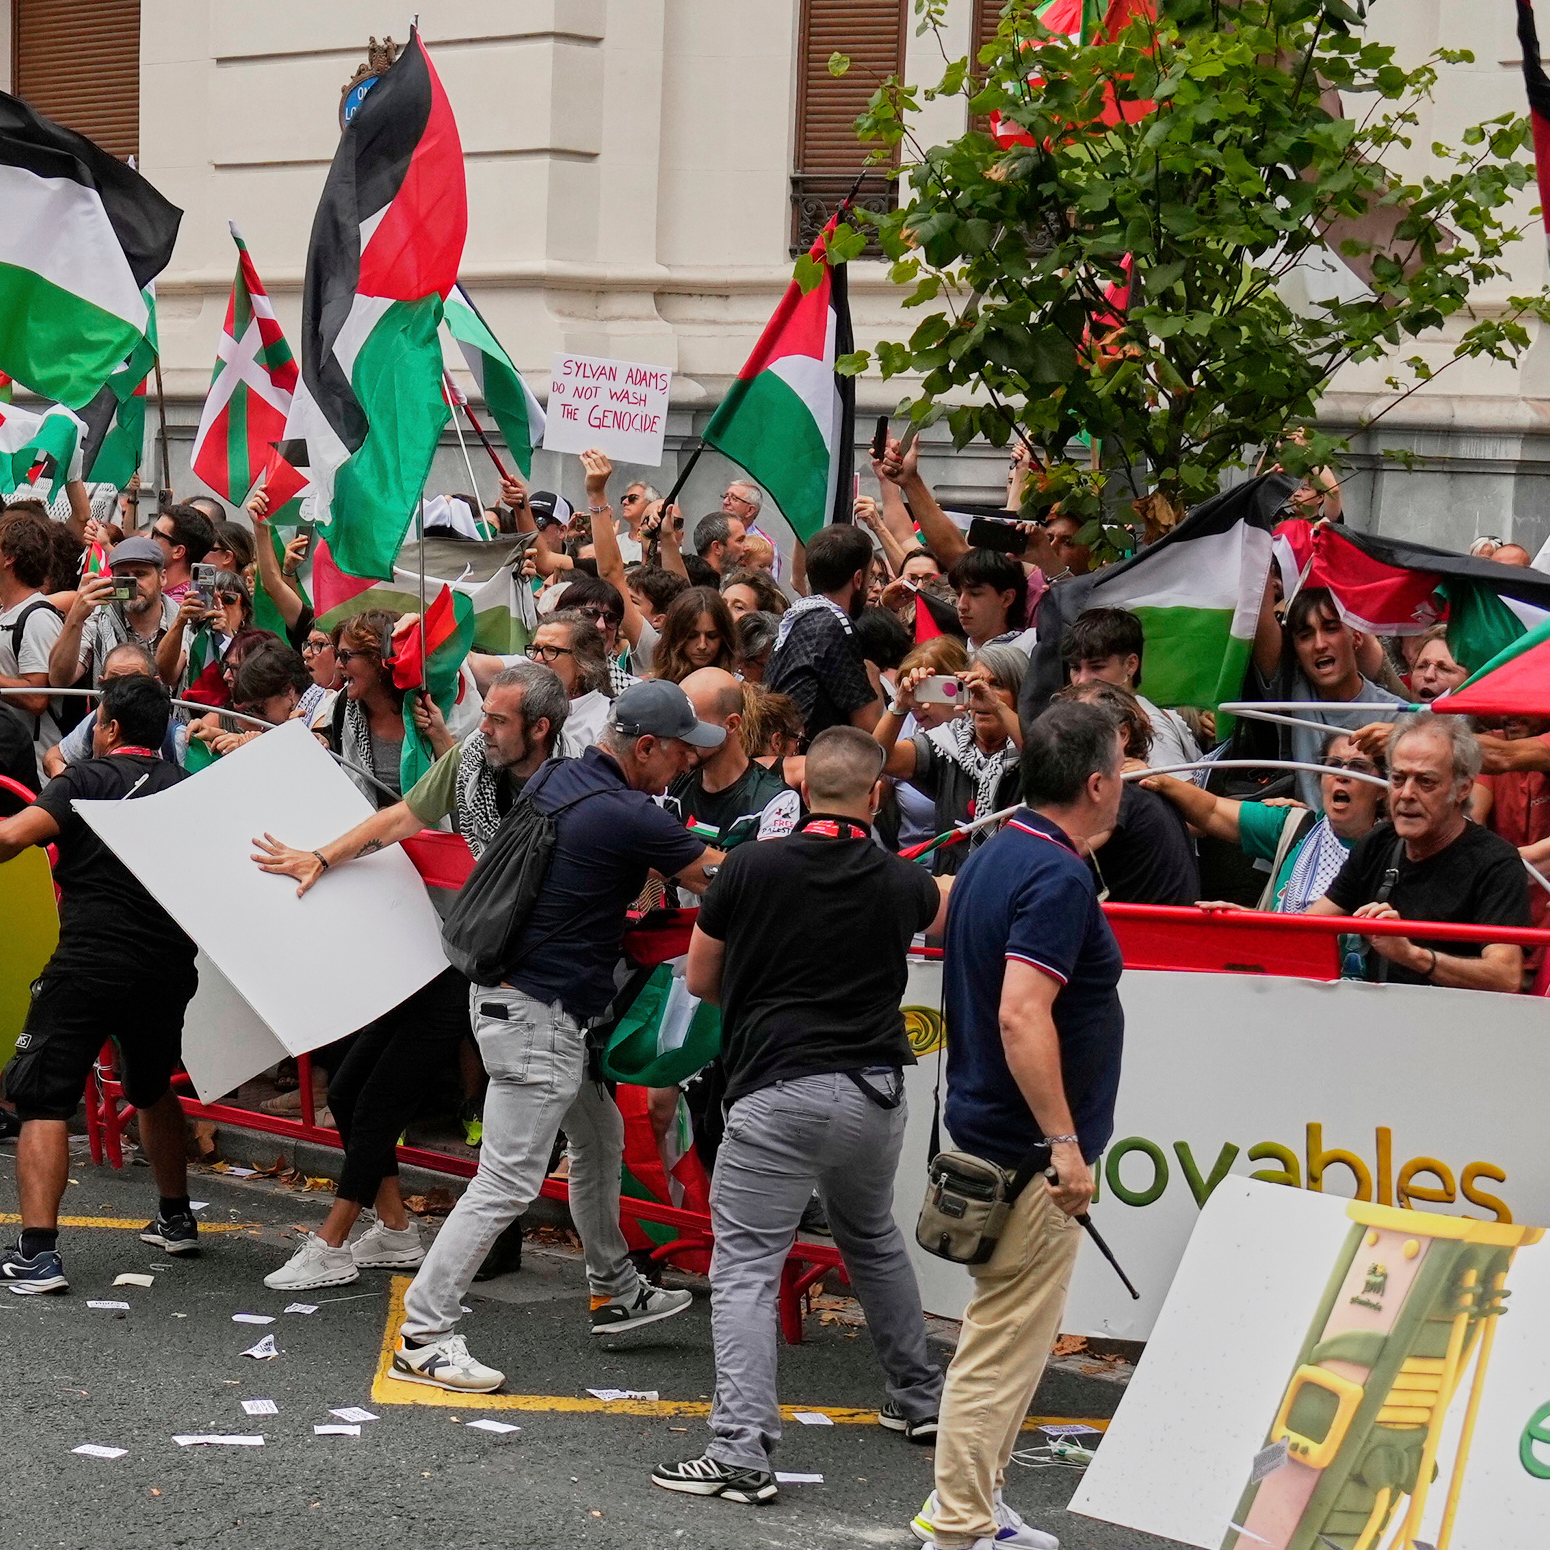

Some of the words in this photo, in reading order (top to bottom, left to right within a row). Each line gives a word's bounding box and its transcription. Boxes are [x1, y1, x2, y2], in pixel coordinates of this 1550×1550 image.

[563, 359, 618, 382] SYLVAN
[552, 381, 566, 394] DO
[573, 386, 602, 400] NOT
[609, 387, 647, 407] WASH
[561, 403, 580, 421] THE
[588, 404, 661, 434] GENOCIDE
